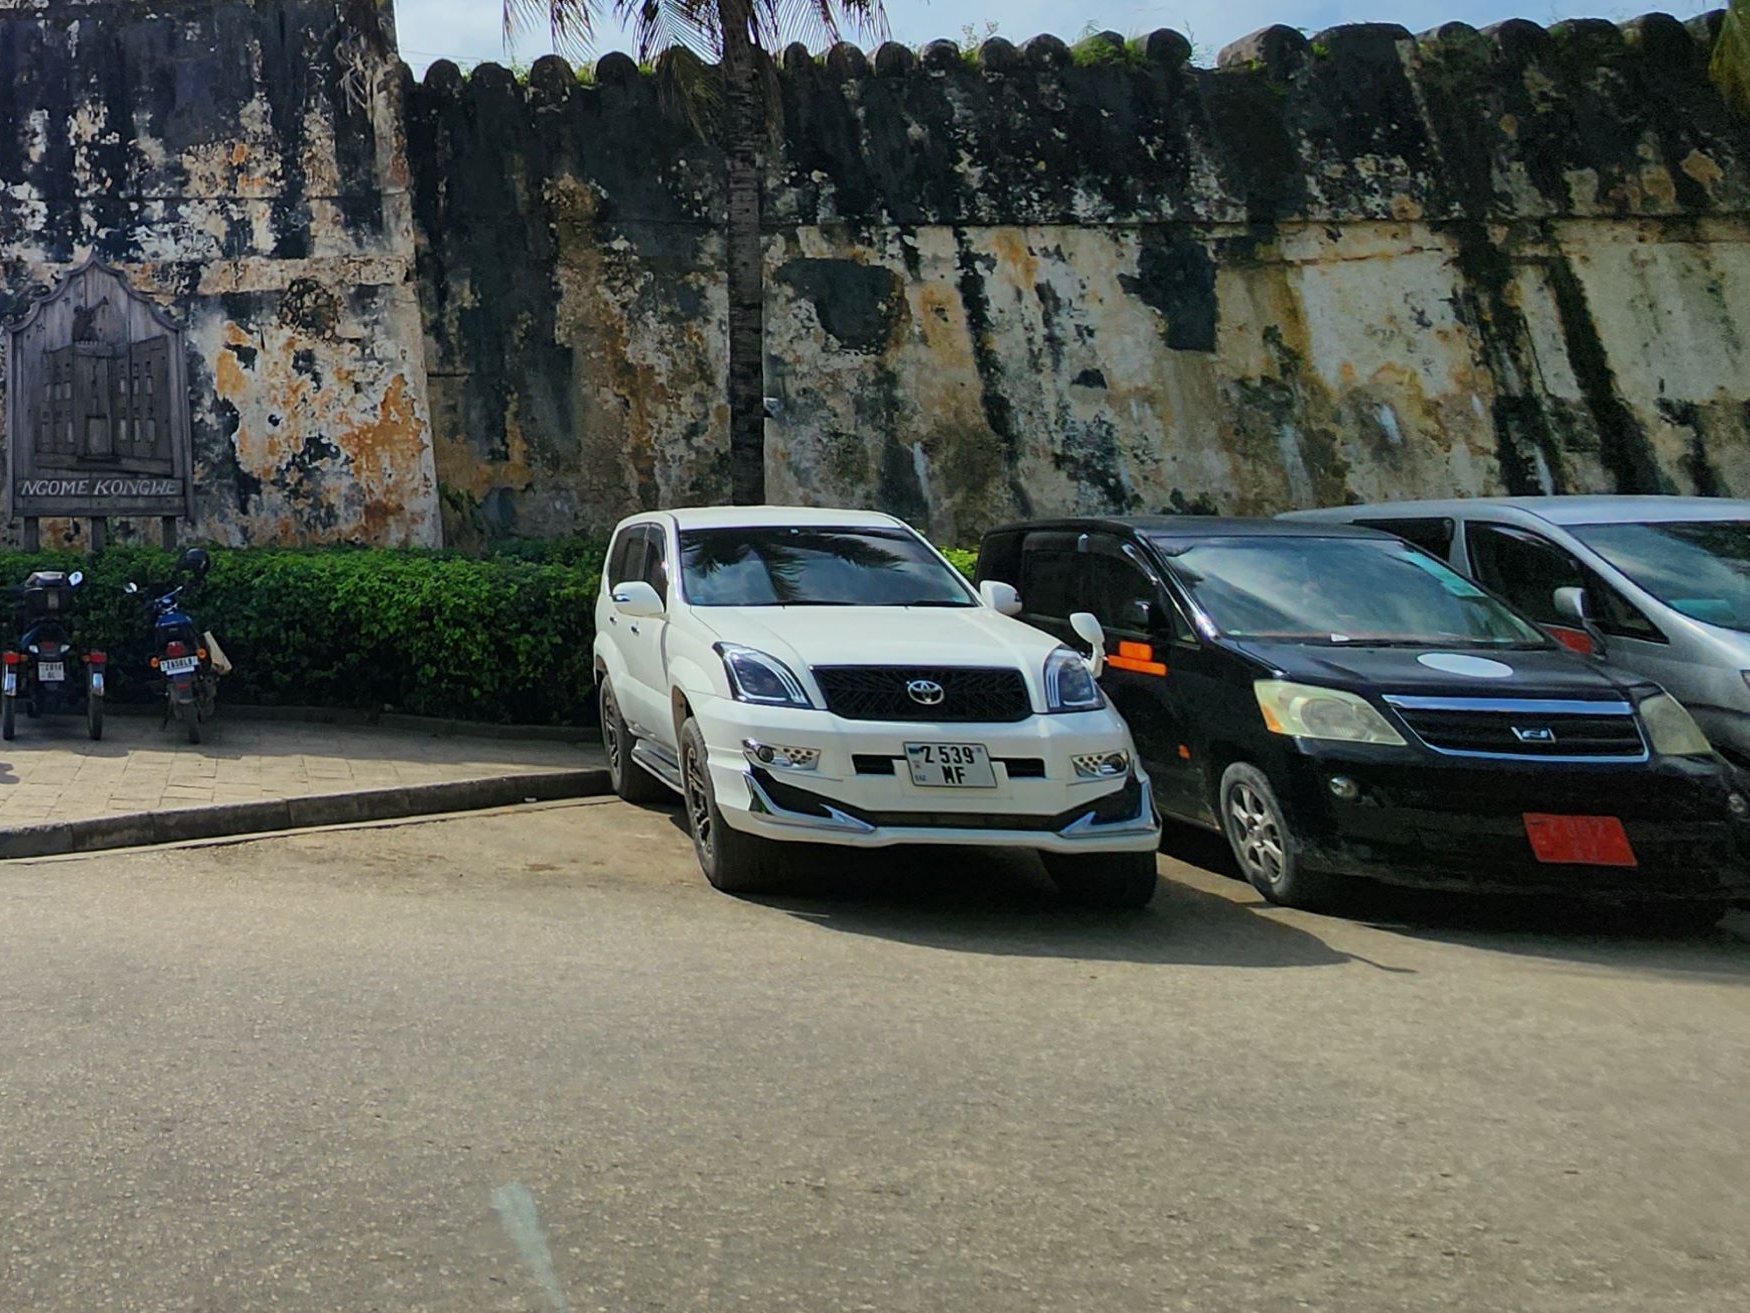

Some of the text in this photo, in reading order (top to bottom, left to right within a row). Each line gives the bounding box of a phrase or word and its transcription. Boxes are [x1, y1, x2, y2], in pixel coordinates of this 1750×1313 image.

[21, 479, 178, 495] NGOME KONGWE
[938, 745, 975, 764] 539
